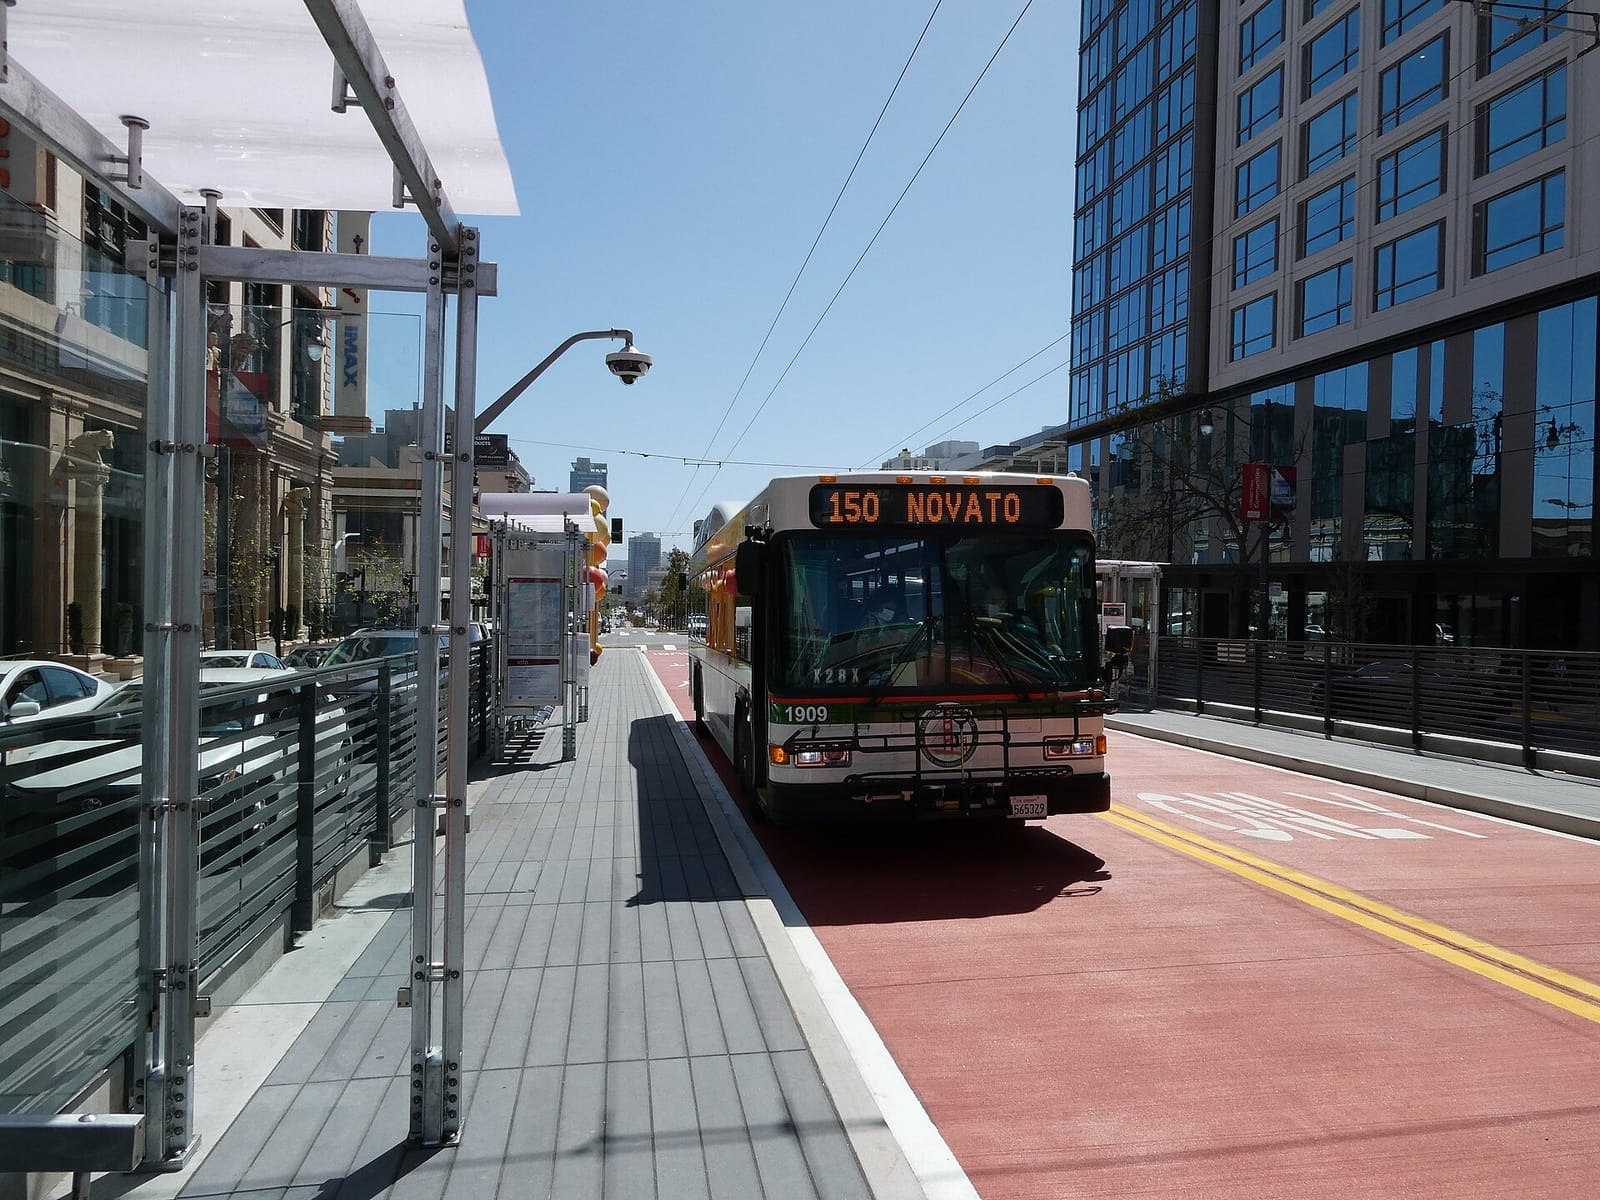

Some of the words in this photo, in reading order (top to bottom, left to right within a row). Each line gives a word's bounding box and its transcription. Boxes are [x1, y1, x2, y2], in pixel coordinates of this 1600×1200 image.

[344, 325, 358, 388] IMAX
[829, 491, 880, 523] 150
[907, 492, 1020, 523] NOVATO
[785, 706, 828, 722] 1909
[1014, 803, 1045, 815] 565329
[1137, 791, 1488, 842] ONLY
